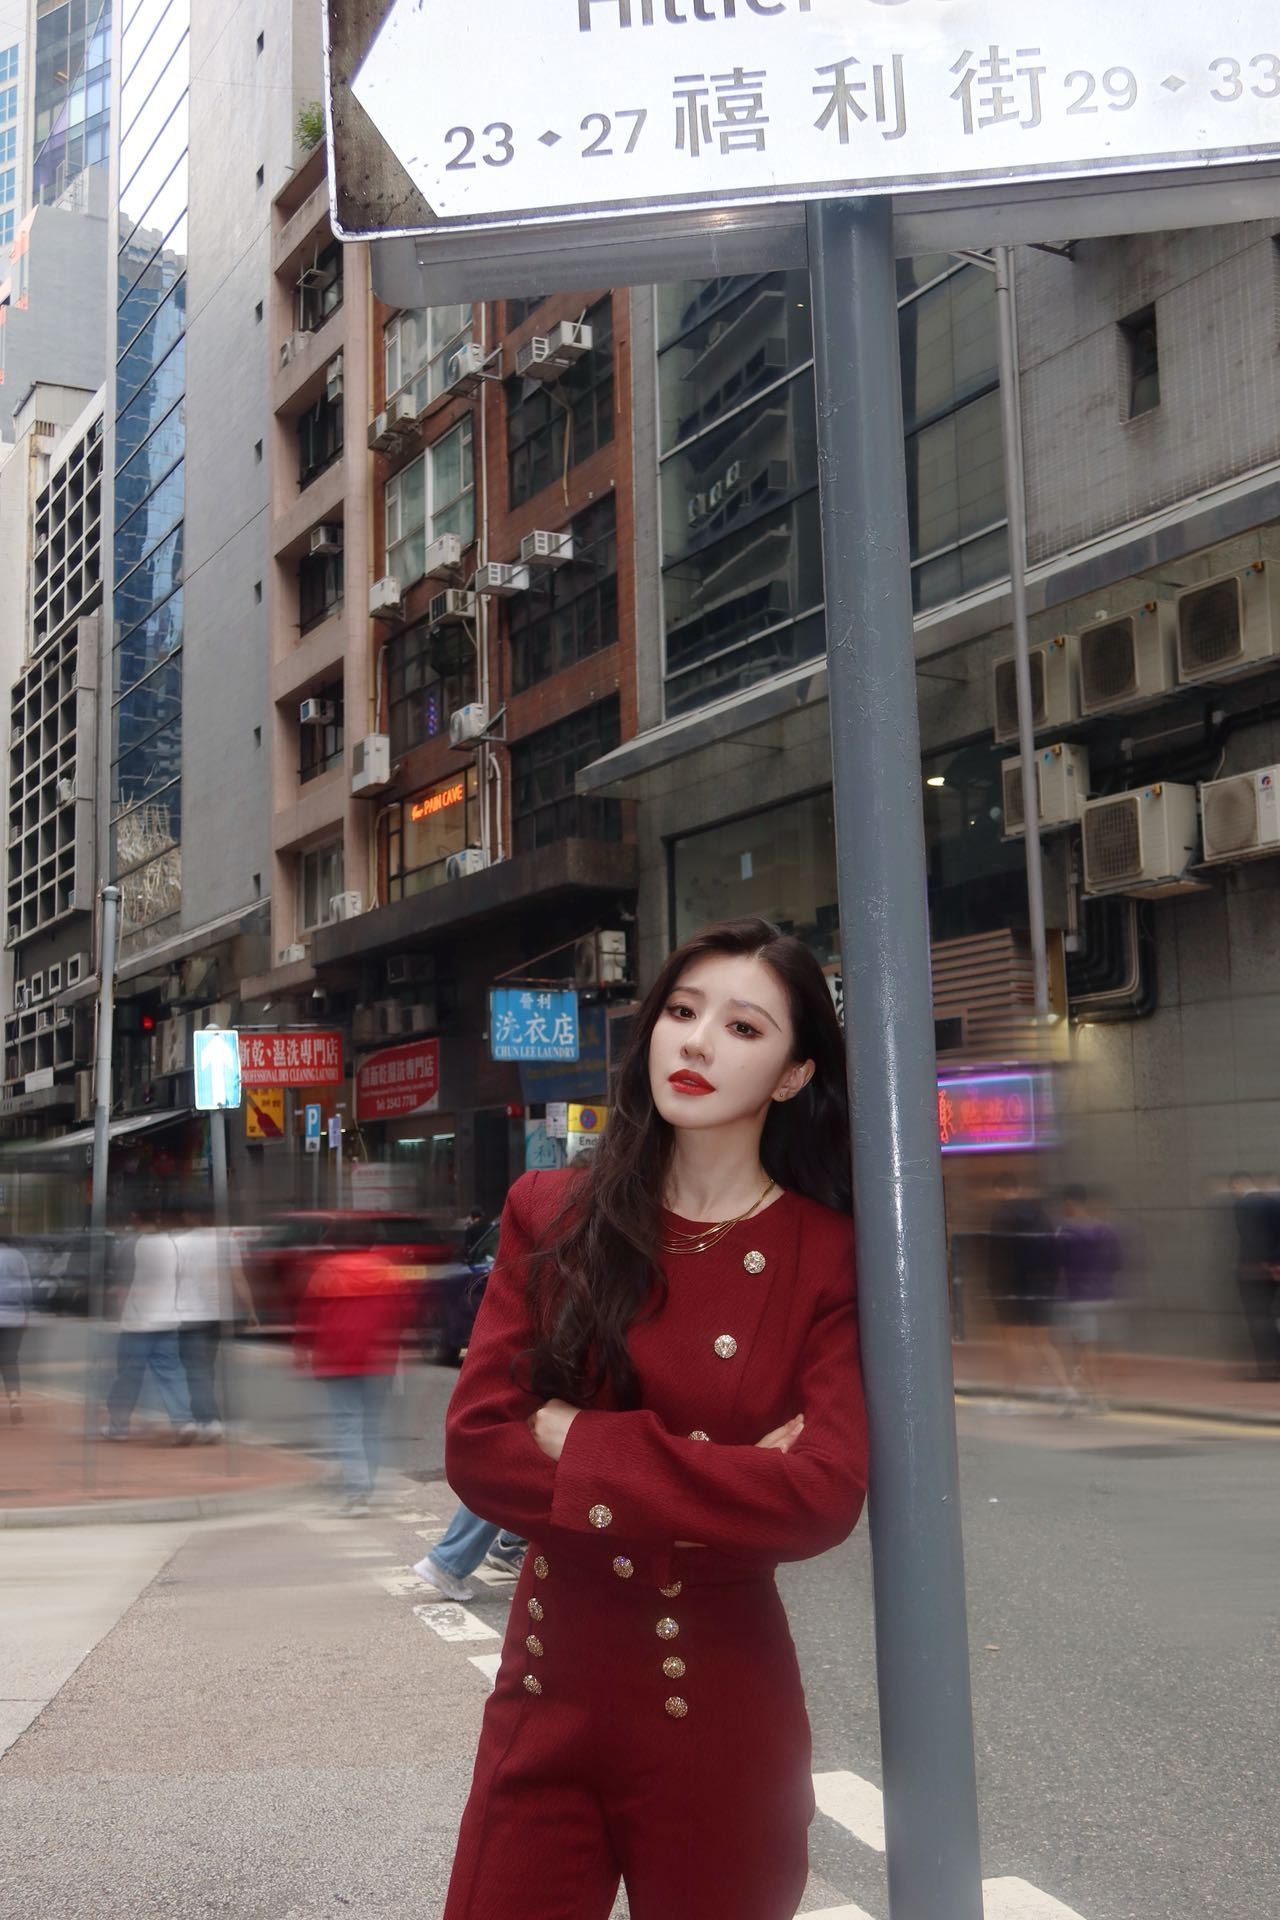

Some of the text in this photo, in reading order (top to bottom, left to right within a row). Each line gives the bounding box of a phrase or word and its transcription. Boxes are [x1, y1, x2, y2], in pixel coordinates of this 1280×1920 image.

[444, 45, 1280, 171] 23 27 禧利街 29 33
[442, 784, 464, 807] CAVE
[495, 1010, 575, 1045] 洗衣店
[495, 1045, 575, 1058] CHUN LEE LAUNDRY
[308, 1108, 318, 1136] P
